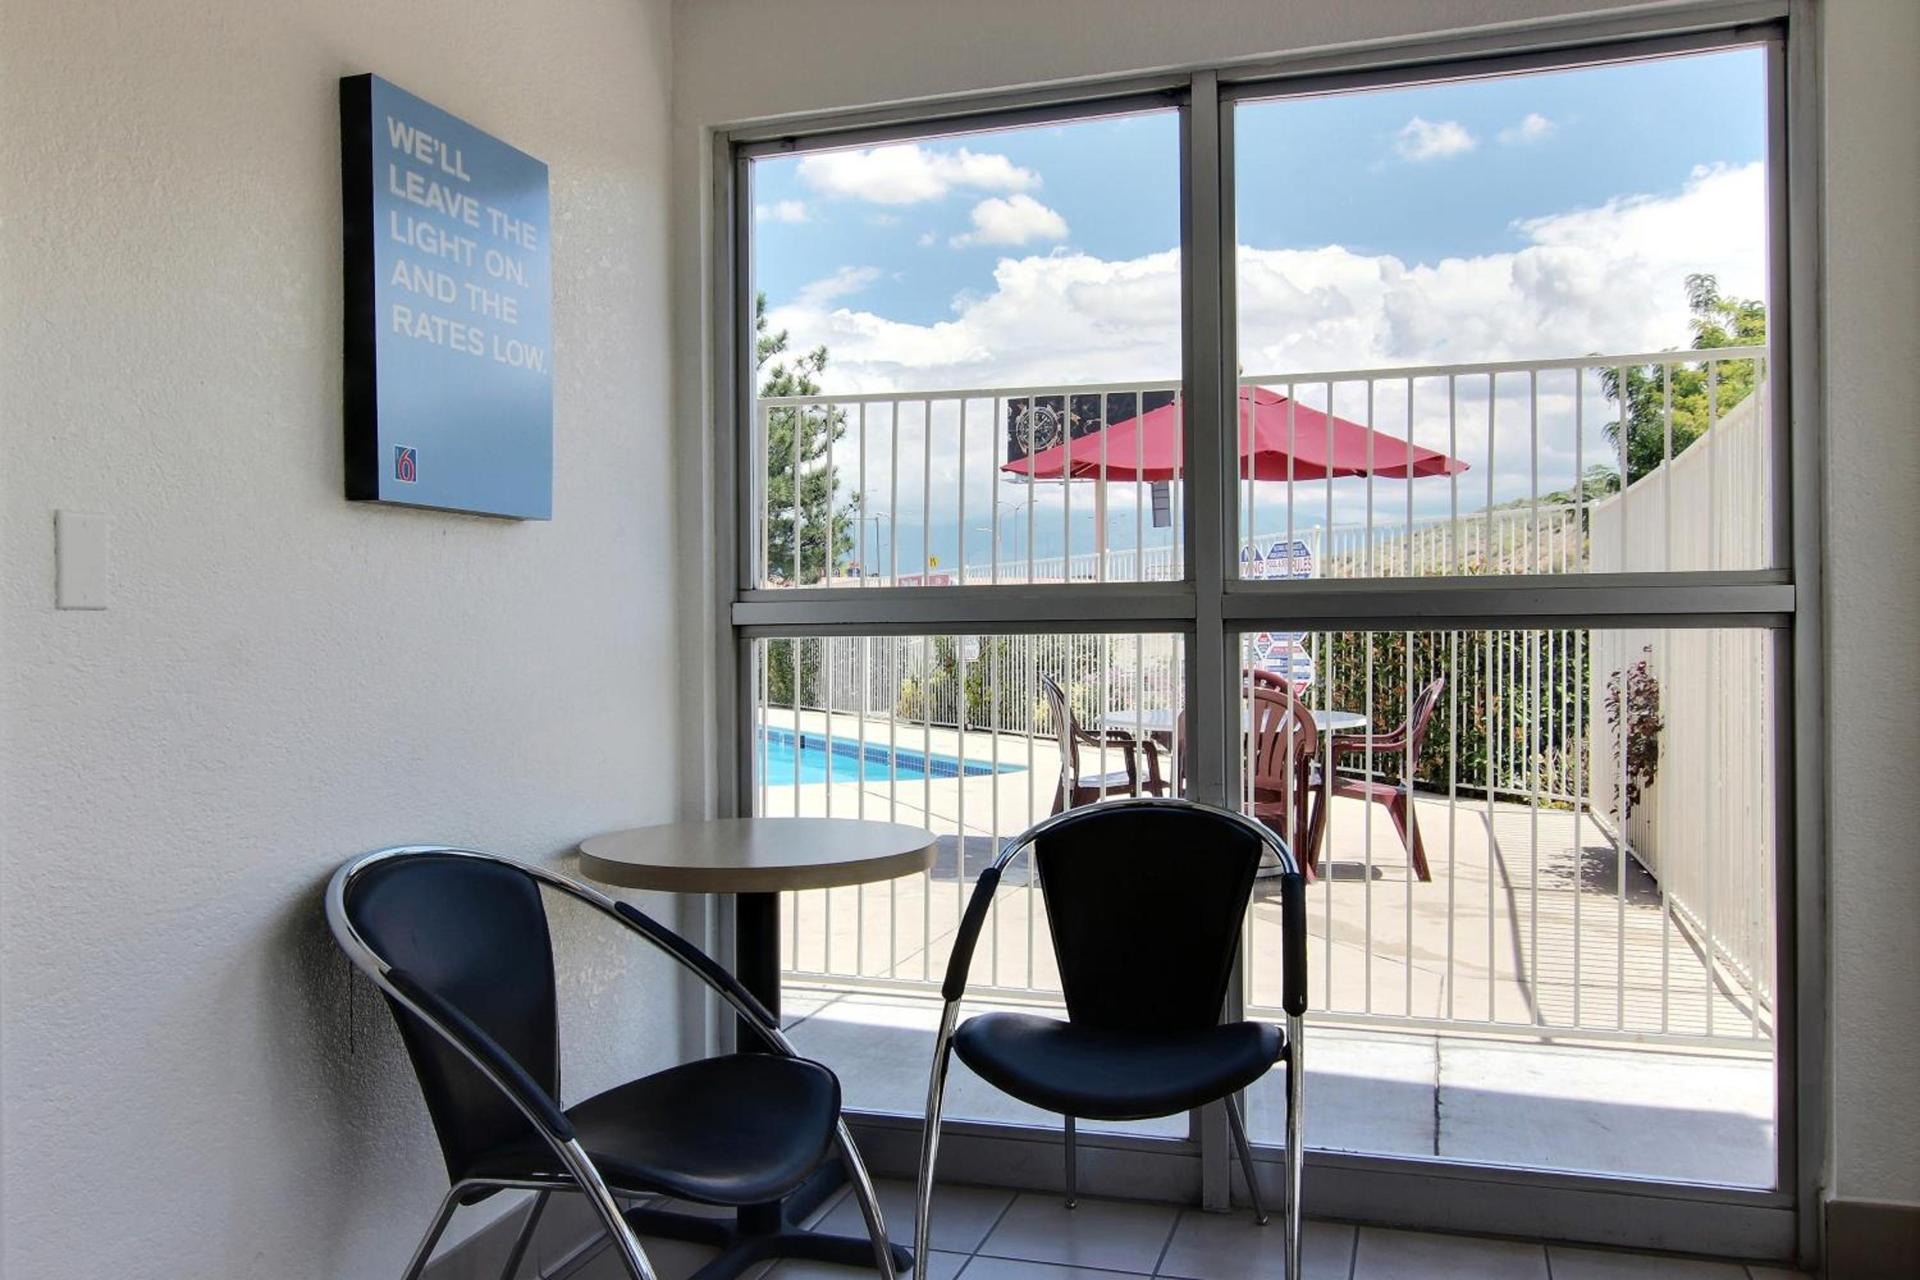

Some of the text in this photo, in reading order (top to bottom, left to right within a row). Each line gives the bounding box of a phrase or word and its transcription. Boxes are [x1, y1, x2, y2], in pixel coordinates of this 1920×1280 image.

[387, 115, 470, 182] WE'LL
[390, 163, 537, 251] LEAVE THE
[391, 210, 529, 288] LIGHT ON.
[391, 259, 518, 325] AND THE
[393, 303, 548, 375] RATES LOW.
